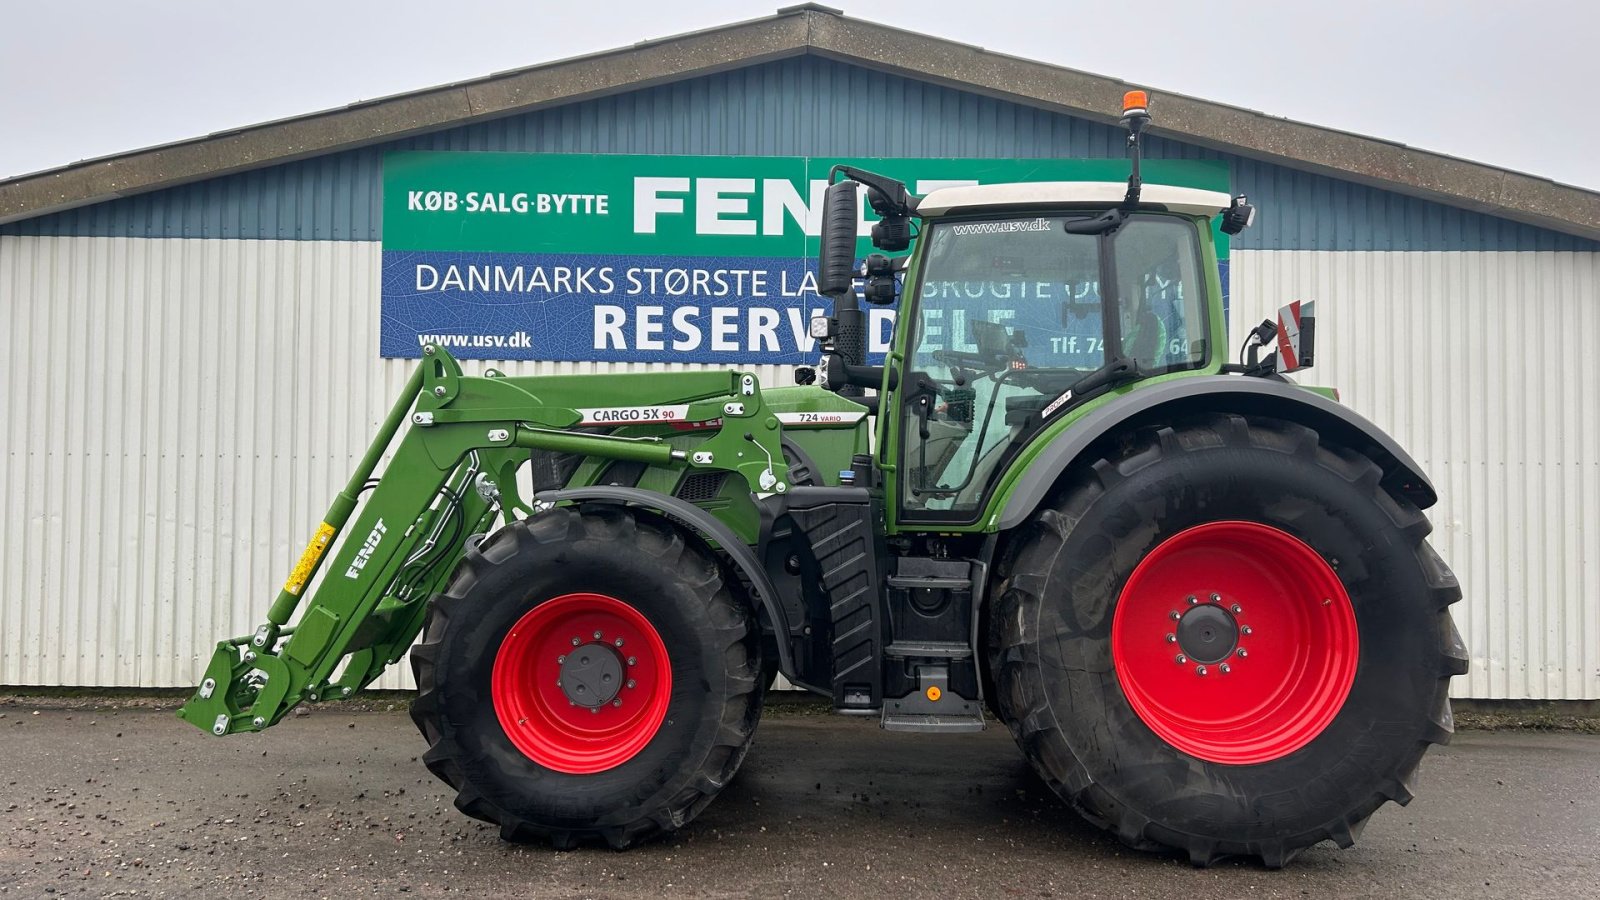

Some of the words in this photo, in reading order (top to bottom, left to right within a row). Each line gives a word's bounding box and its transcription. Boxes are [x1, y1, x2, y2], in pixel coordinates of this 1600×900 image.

[953, 217, 1051, 236] www.usv.dk
[415, 264, 614, 294] DANMARKS
[626, 268, 768, 296] STØRSTE
[417, 331, 532, 349] www.usv.dk
[1050, 336, 1081, 354] Tlf.
[593, 409, 640, 421] CARGO
[643, 408, 660, 419] 5X
[662, 410, 675, 419] 90
[799, 413, 818, 422] 724
[344, 517, 388, 579] FENDT
